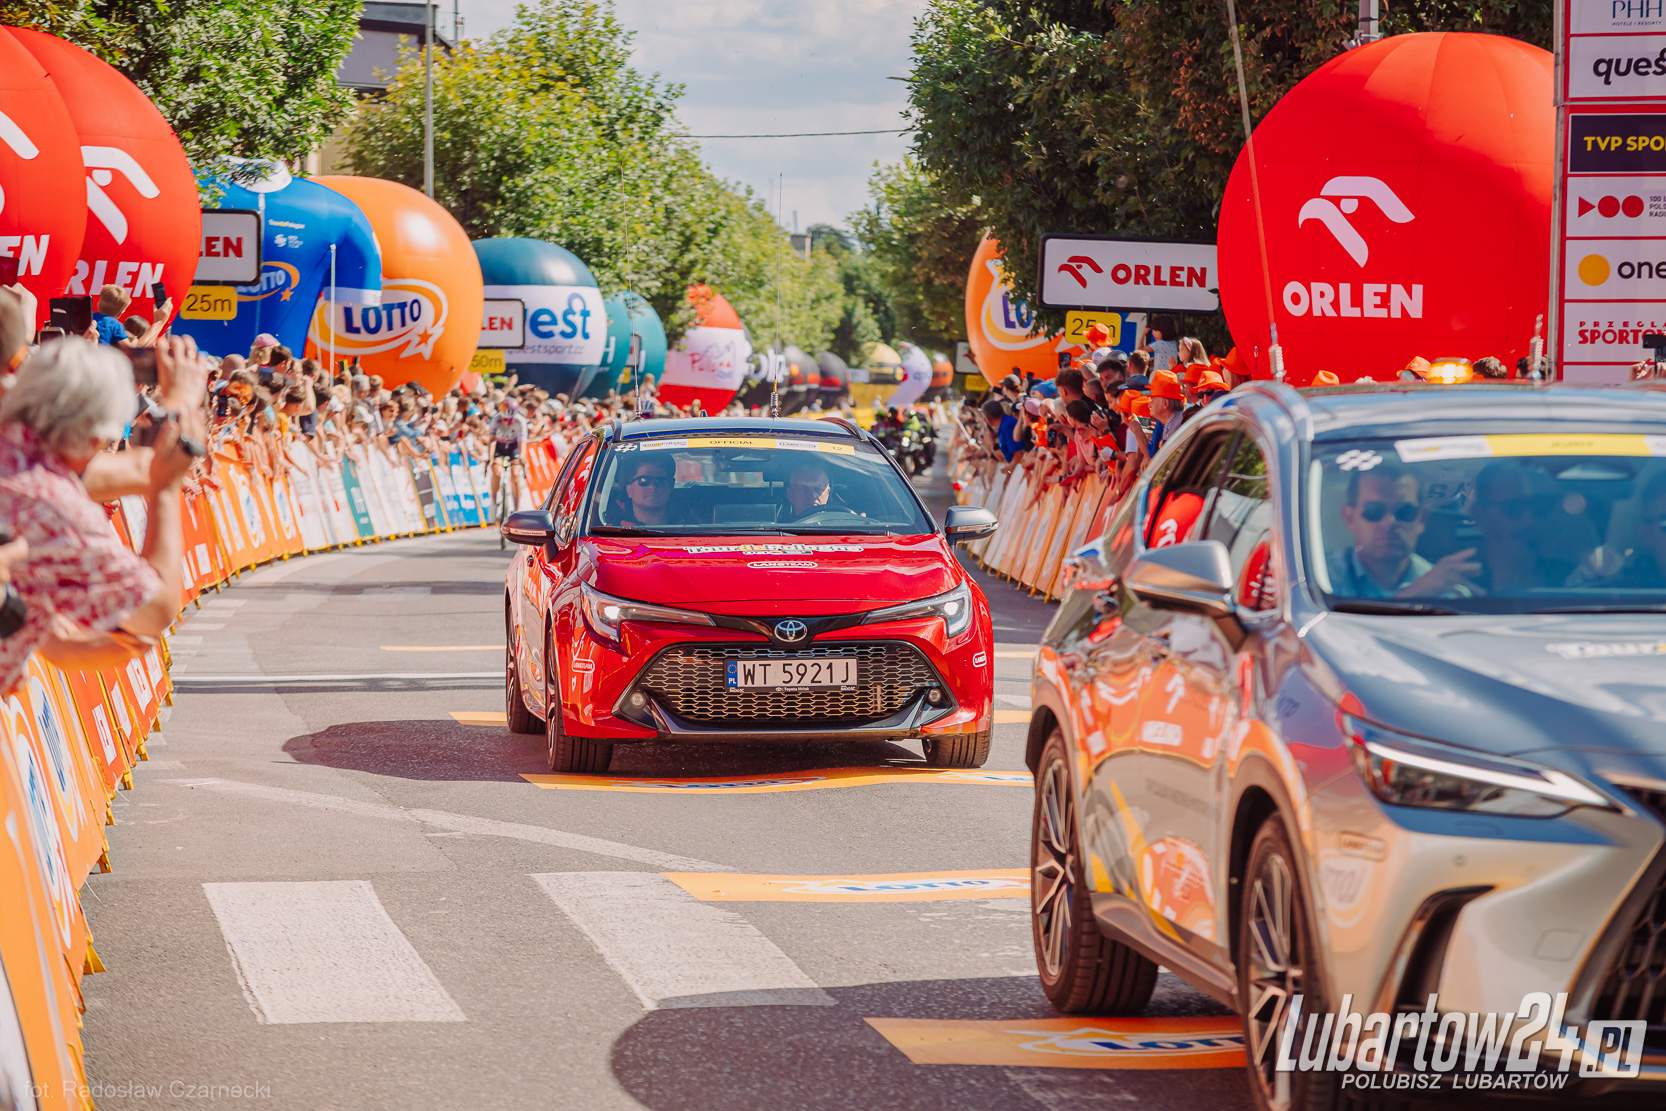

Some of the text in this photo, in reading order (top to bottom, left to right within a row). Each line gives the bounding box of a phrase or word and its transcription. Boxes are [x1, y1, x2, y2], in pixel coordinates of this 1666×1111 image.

[1584, 136, 1622, 152] TVP
[199, 236, 244, 258] EN
[1110, 263, 1208, 289] ORLEN
[186, 293, 233, 313] 25m
[1282, 280, 1424, 320] ORLEN
[343, 298, 422, 336] LOTTO
[480, 316, 514, 332] EN
[524, 292, 591, 341] est
[1577, 328, 1665, 345] SPORT
[727, 677, 737, 685] PL
[742, 661, 850, 685] WT 5921J
